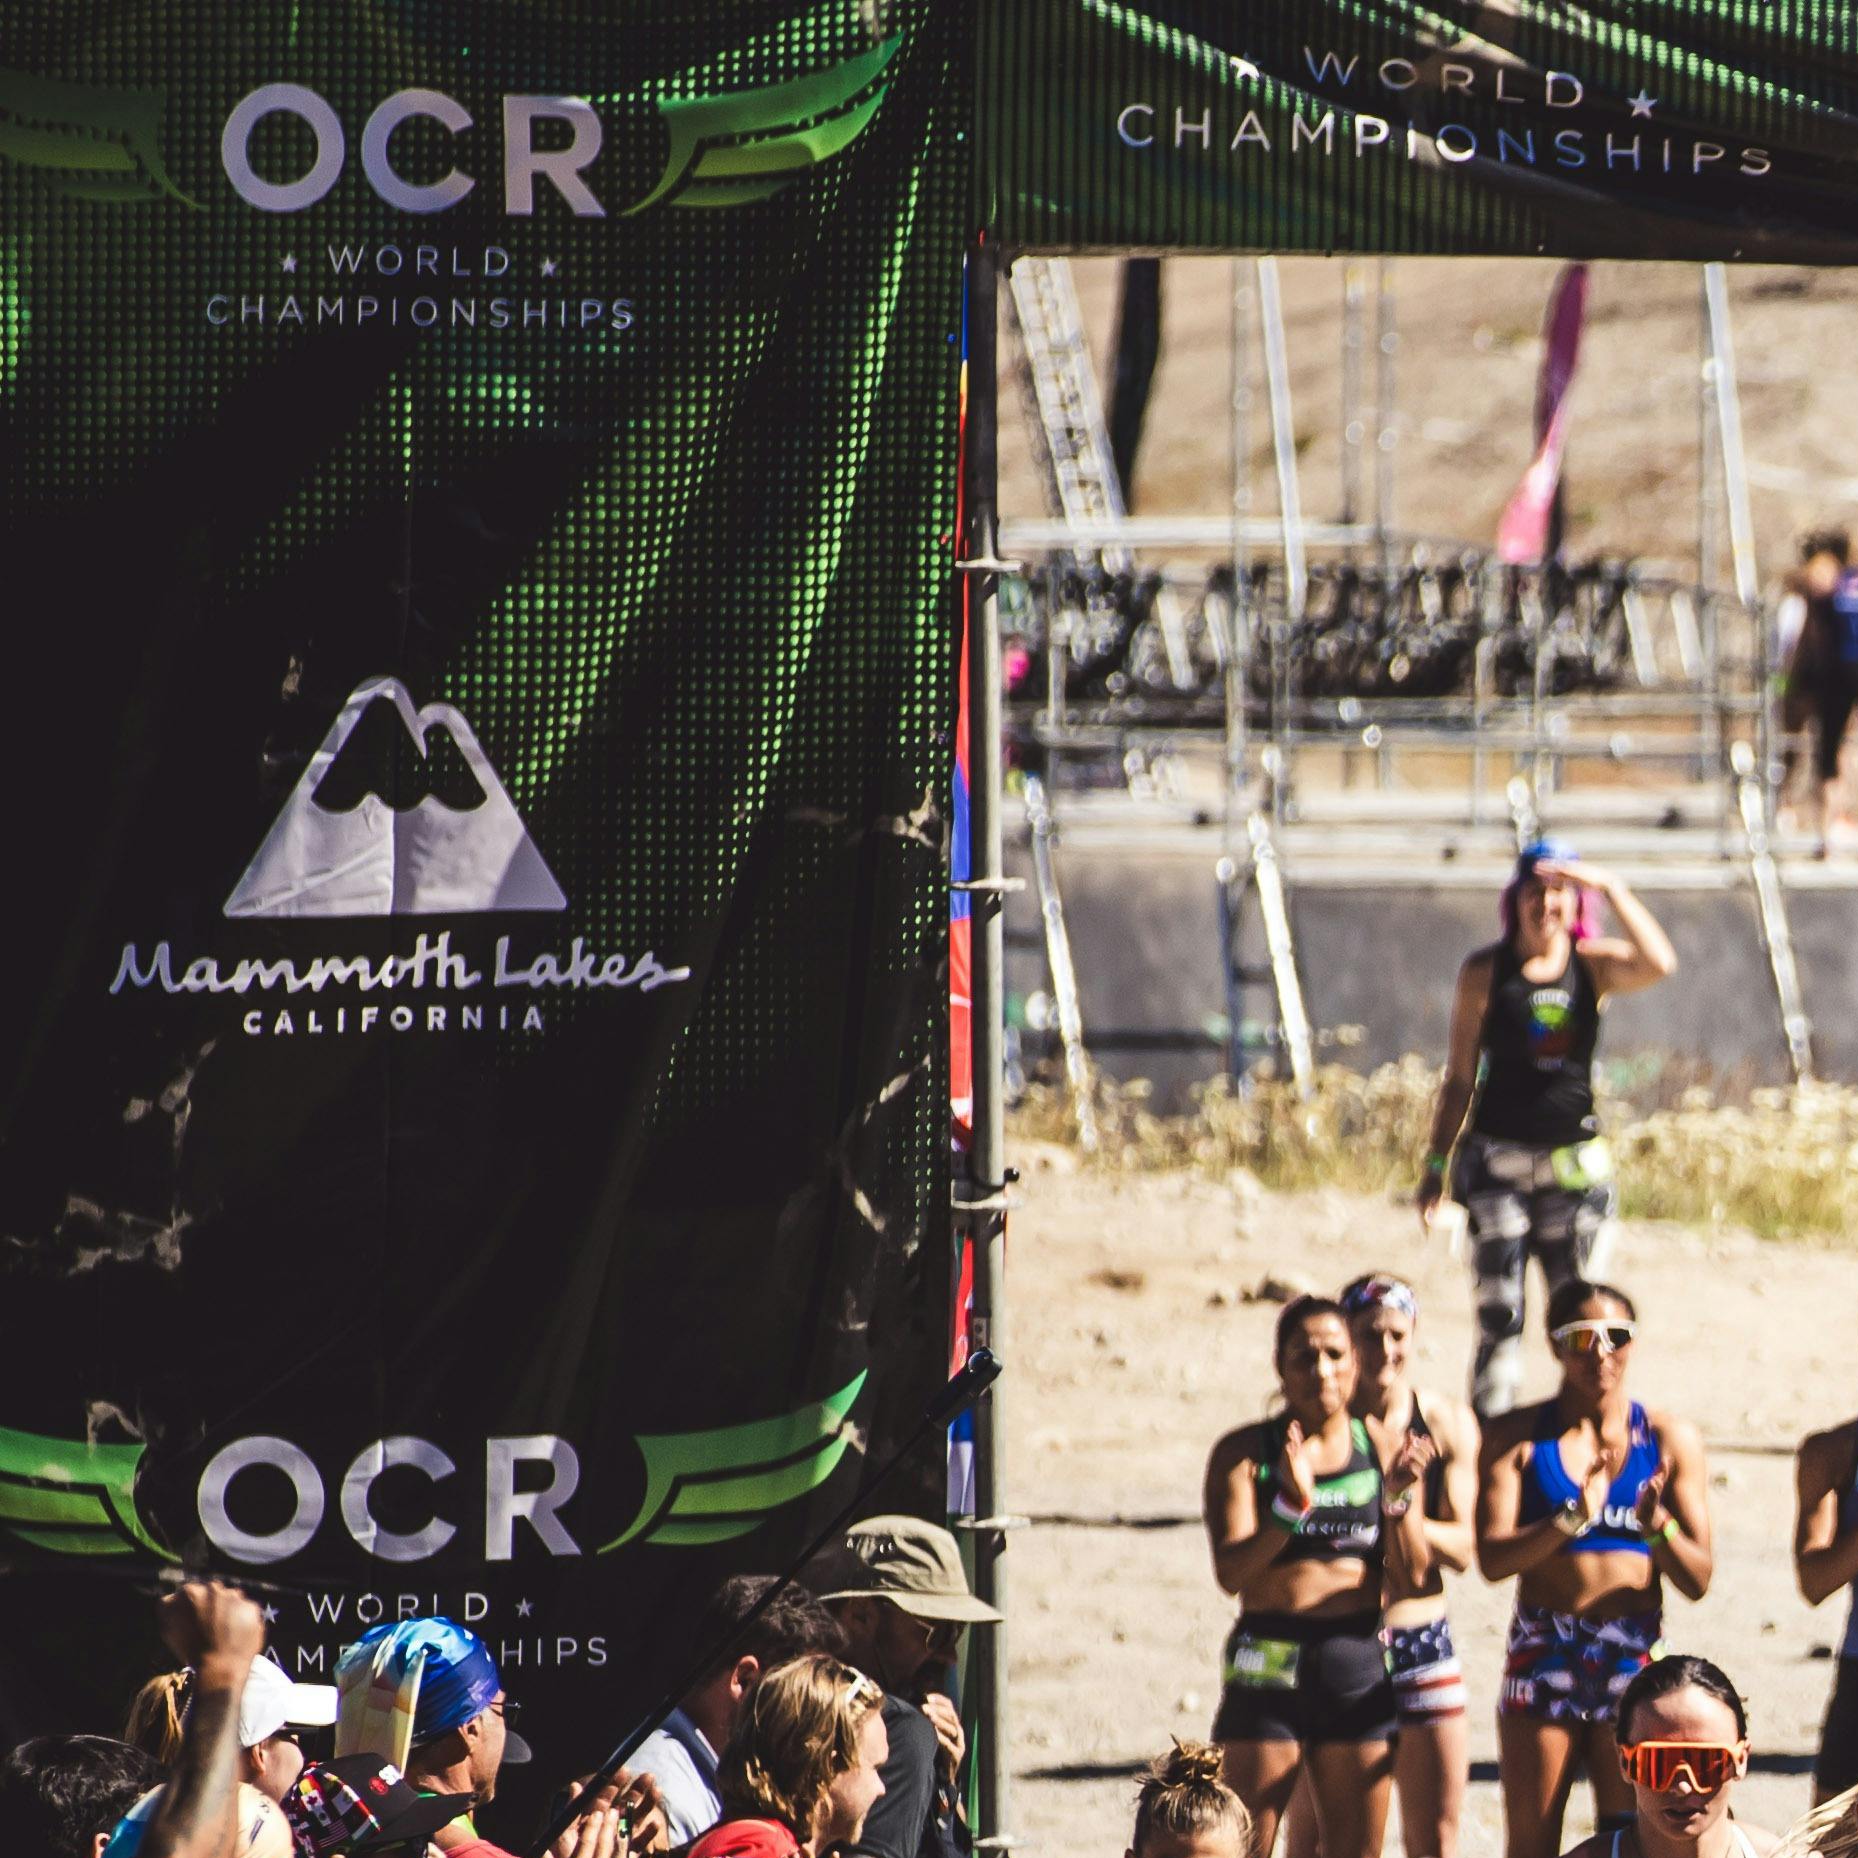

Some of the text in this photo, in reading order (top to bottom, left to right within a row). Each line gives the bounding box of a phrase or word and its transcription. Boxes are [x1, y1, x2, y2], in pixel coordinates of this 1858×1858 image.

[1303, 45, 1585, 109] WORLD
[221, 83, 607, 218] OCR
[1115, 103, 1773, 178] CHAMPIONSHIPS
[328, 244, 511, 279] WORLD
[205, 294, 635, 330] CHAMPIONSHIPS
[109, 930, 691, 995] Mammoth Lakes
[243, 1005, 544, 1035] CALIFORNIA
[197, 1434, 583, 1564] OCR
